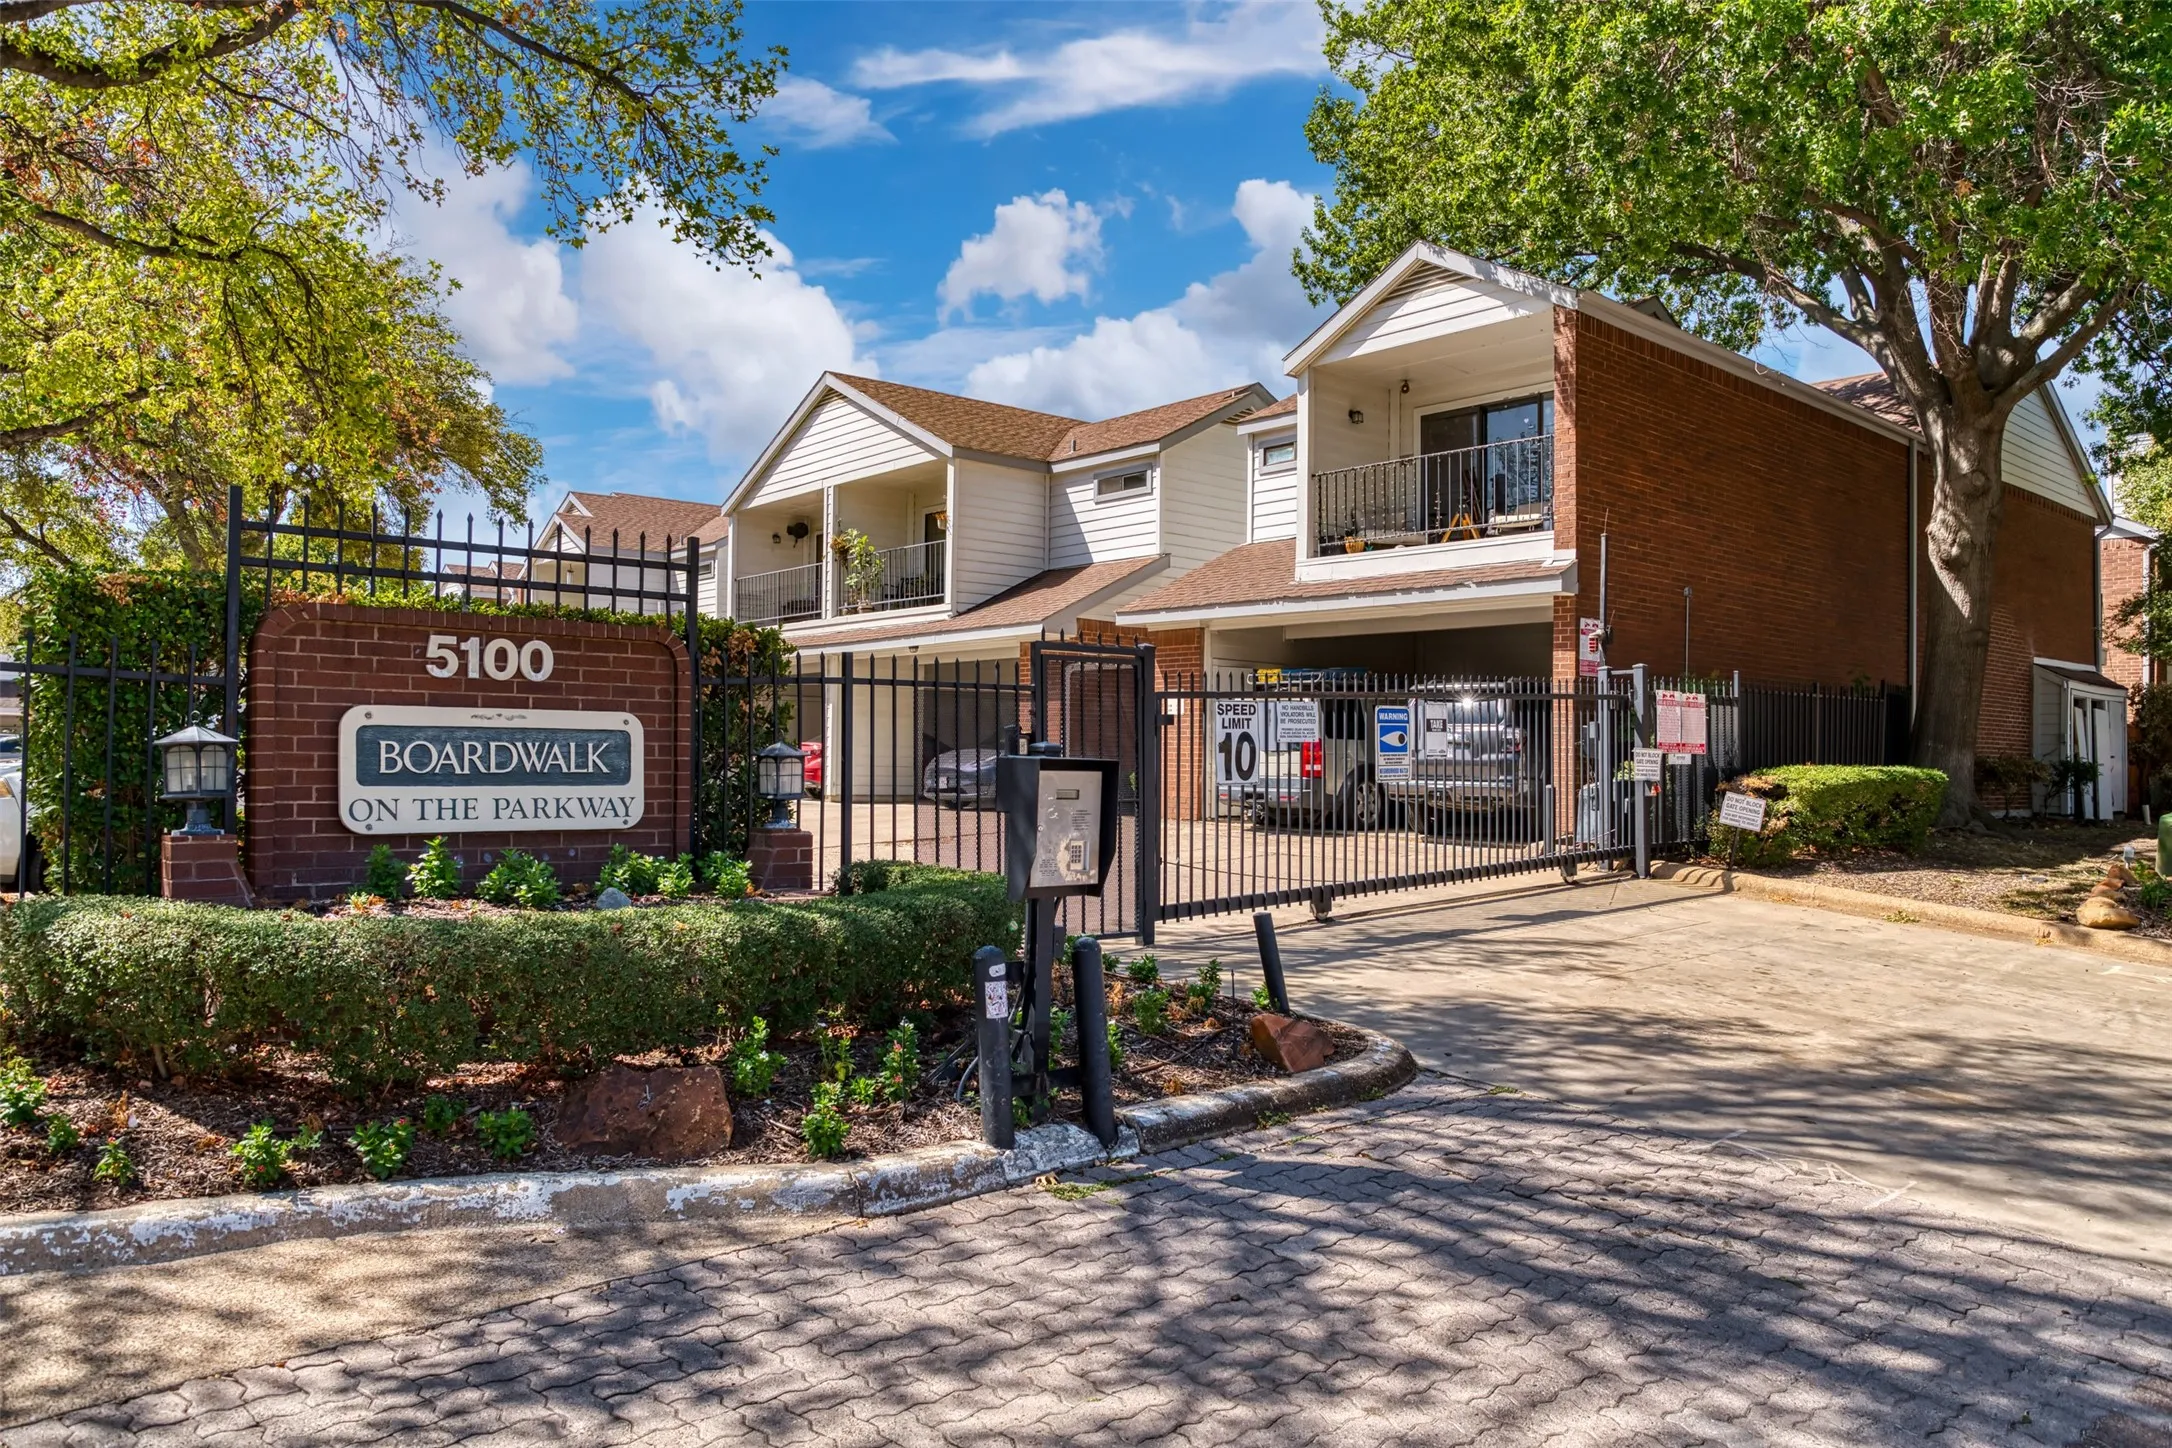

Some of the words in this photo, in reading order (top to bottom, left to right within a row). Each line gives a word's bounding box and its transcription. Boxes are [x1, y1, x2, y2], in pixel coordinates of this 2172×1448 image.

[425, 634, 554, 682] 5100
[1217, 703, 1256, 716] SPEED
[1378, 712, 1408, 721] WARNING
[1222, 717, 1252, 730] LIMIT
[378, 740, 610, 775] BOARDWALK
[1217, 731, 1257, 781] 10
[348, 798, 400, 823] ON
[412, 797, 479, 821] THE
[492, 796, 636, 821] PARKWAY
[1725, 802, 1738, 810] GATE
[1739, 805, 1761, 815] OPENING
[1745, 800, 1762, 809] BLOCK
